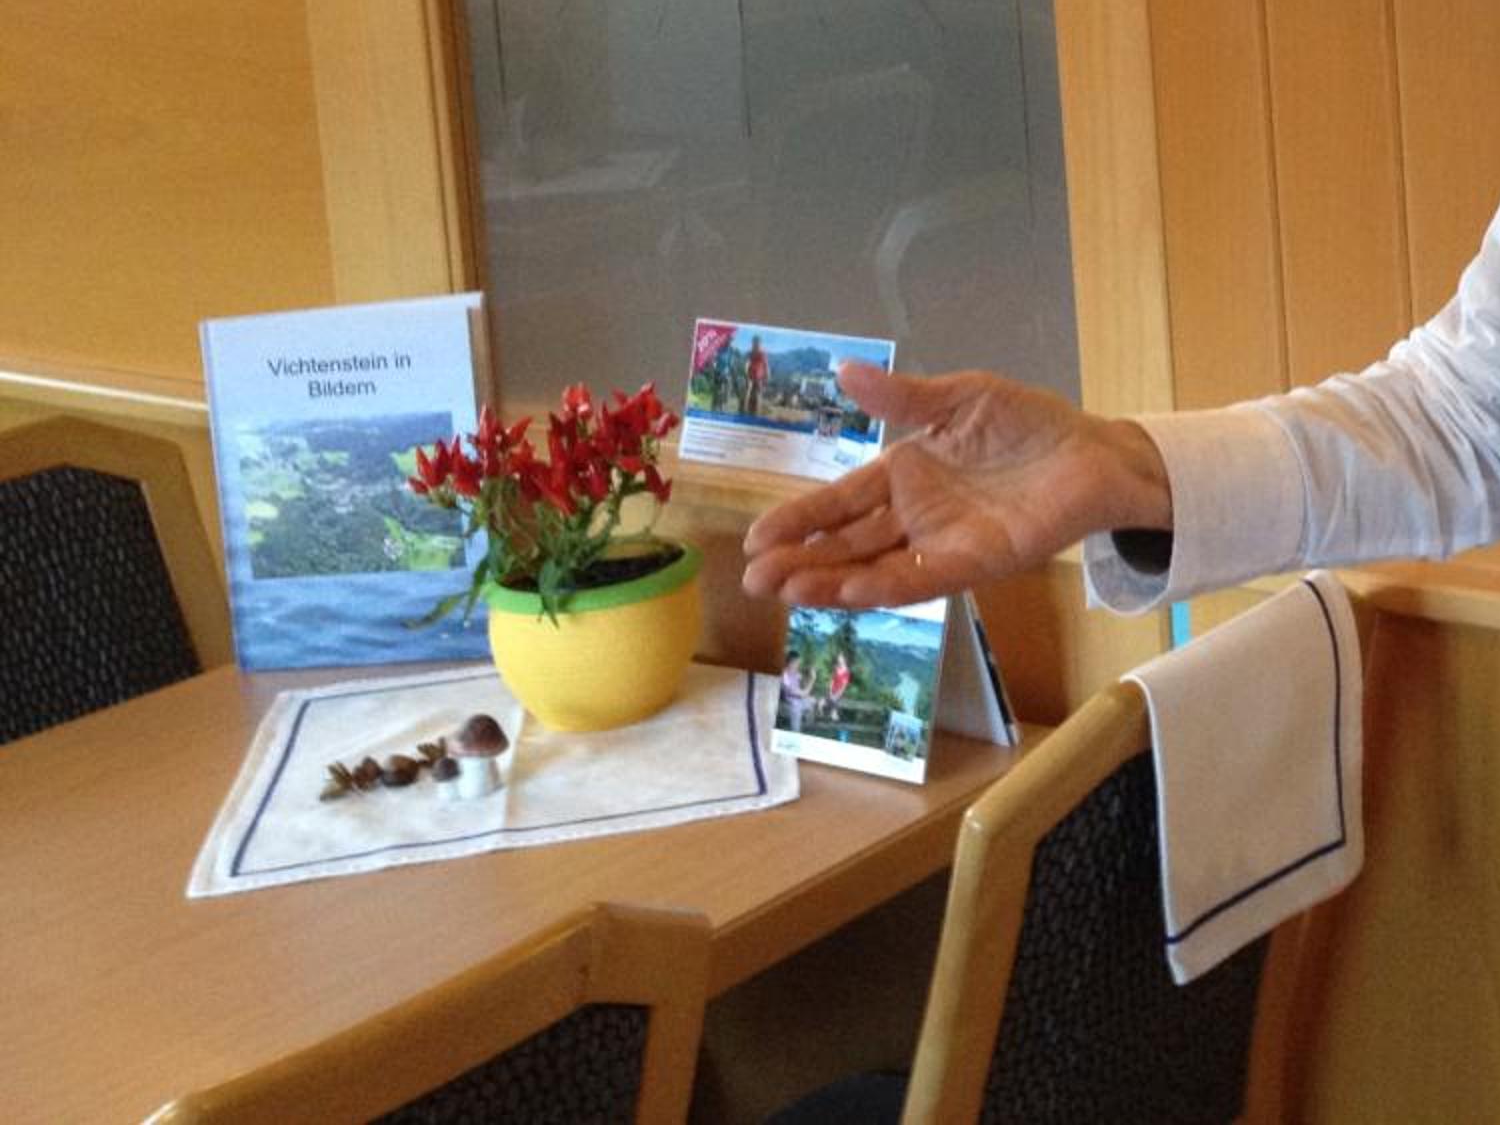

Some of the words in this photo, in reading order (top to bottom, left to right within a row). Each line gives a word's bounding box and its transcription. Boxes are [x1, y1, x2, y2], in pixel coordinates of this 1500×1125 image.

[266, 353, 389, 376] Vichtenstein
[394, 352, 412, 370] in
[307, 379, 377, 398] Bildern
